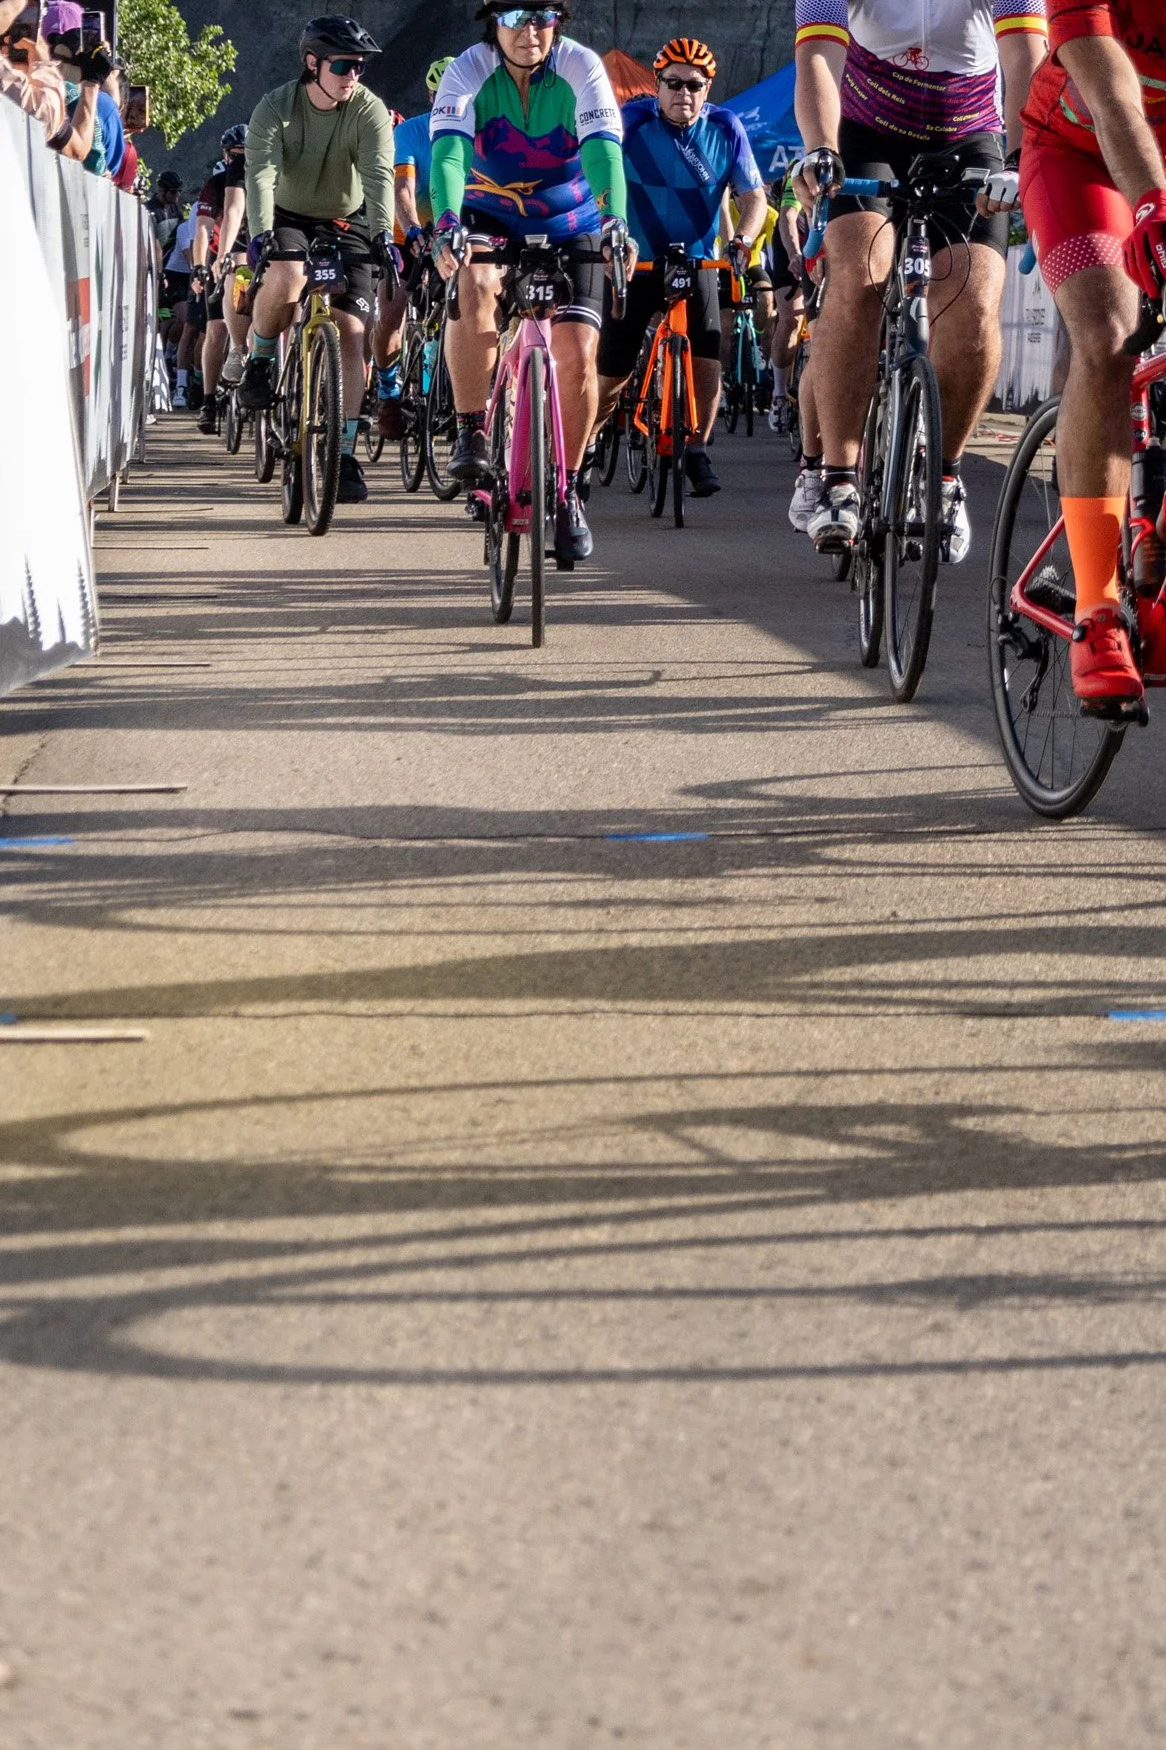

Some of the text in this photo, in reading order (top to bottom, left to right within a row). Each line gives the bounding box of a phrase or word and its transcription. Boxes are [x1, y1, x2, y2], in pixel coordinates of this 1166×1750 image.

[579, 108, 617, 124] CONCRETE
[315, 269, 336, 281] 355
[904, 257, 931, 277] 305
[671, 277, 692, 289] 491
[526, 285, 554, 301] 315
